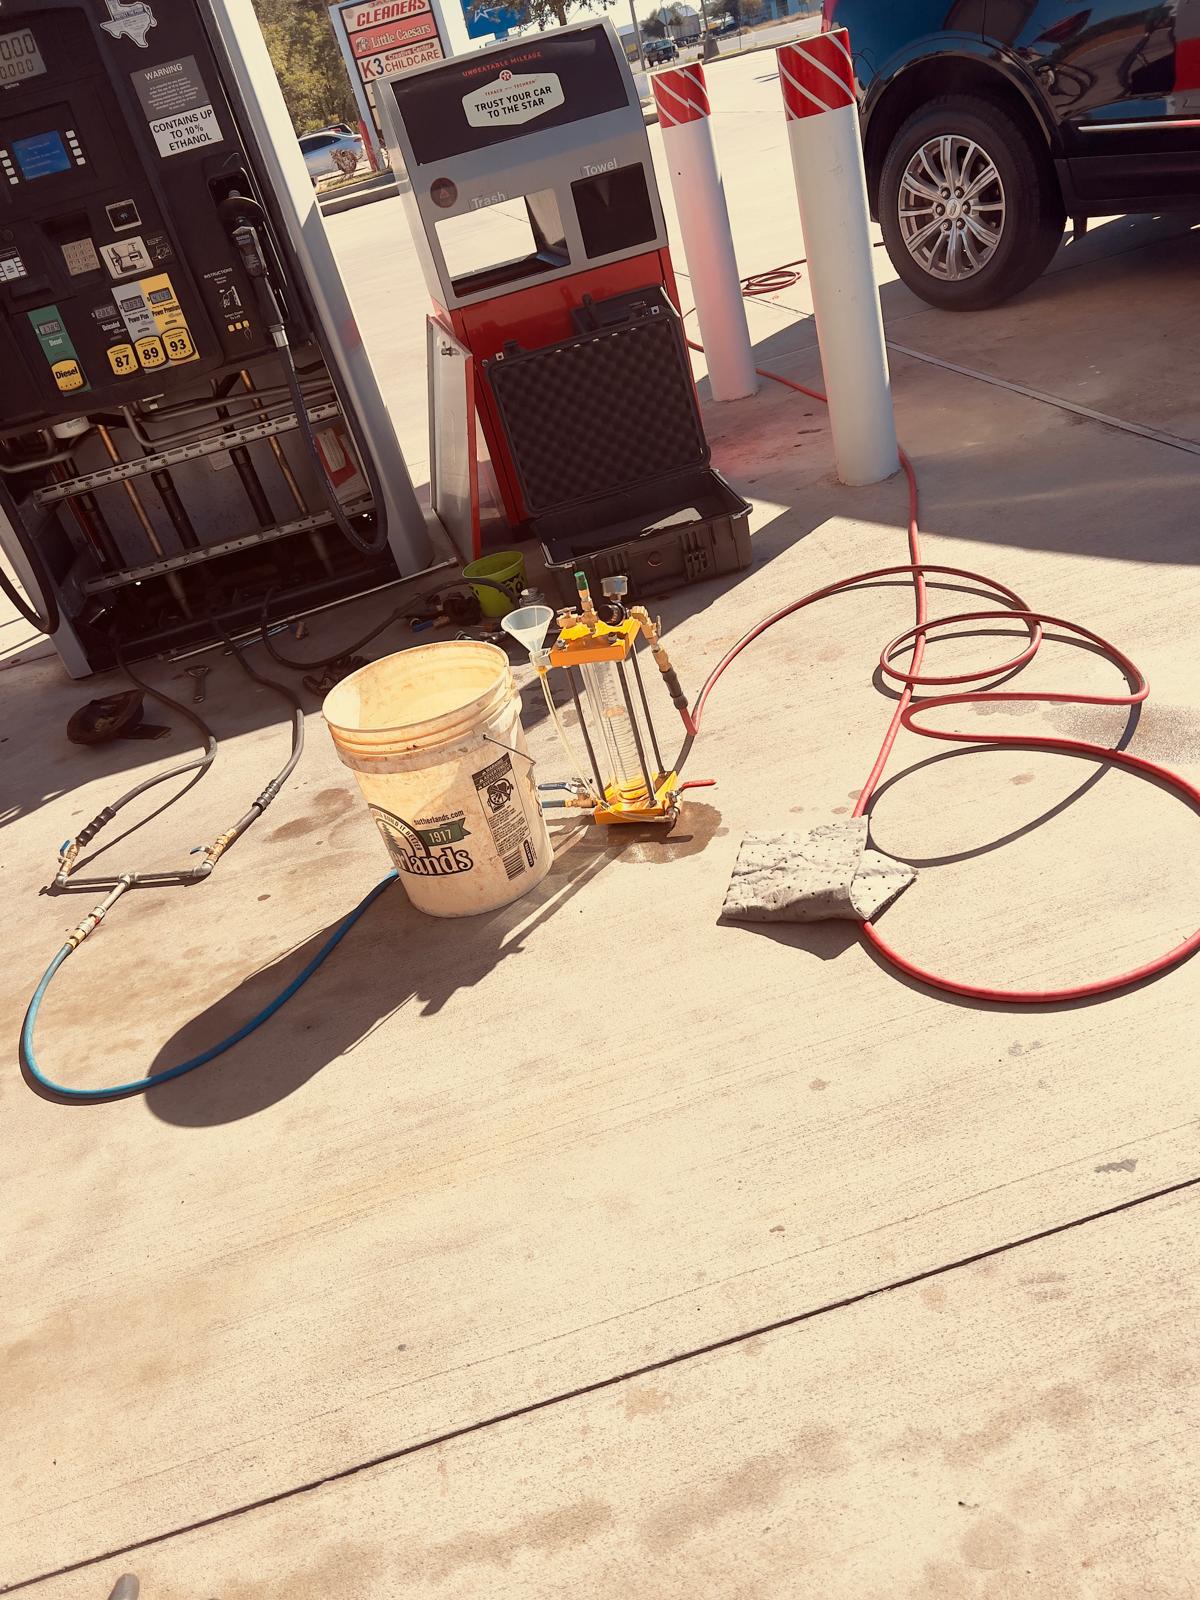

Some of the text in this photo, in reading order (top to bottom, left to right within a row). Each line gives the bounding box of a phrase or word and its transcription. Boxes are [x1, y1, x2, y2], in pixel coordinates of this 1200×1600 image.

[357, 0, 426, 27] CLEANERS
[371, 24, 431, 48] Little Caesars
[144, 63, 183, 80] WARNING
[361, 49, 441, 79] K3 CHILDCARE
[462, 51, 542, 77] UNBEATABLE MILEAGE
[474, 86, 552, 112] TRUST YOUR CAR
[487, 98, 545, 119] TO THE STAR
[153, 109, 213, 133] CONTAINS UP
[169, 132, 212, 151] ETHANOL
[170, 130, 183, 140] TO
[583, 158, 617, 176] Towel
[471, 192, 506, 209] Trash
[115, 354, 130, 368] 87
[142, 347, 159, 360] 89
[170, 339, 186, 352] 93
[55, 367, 78, 379] Diesel
[413, 809, 465, 826] sutherlands.com
[428, 829, 452, 844] 1917
